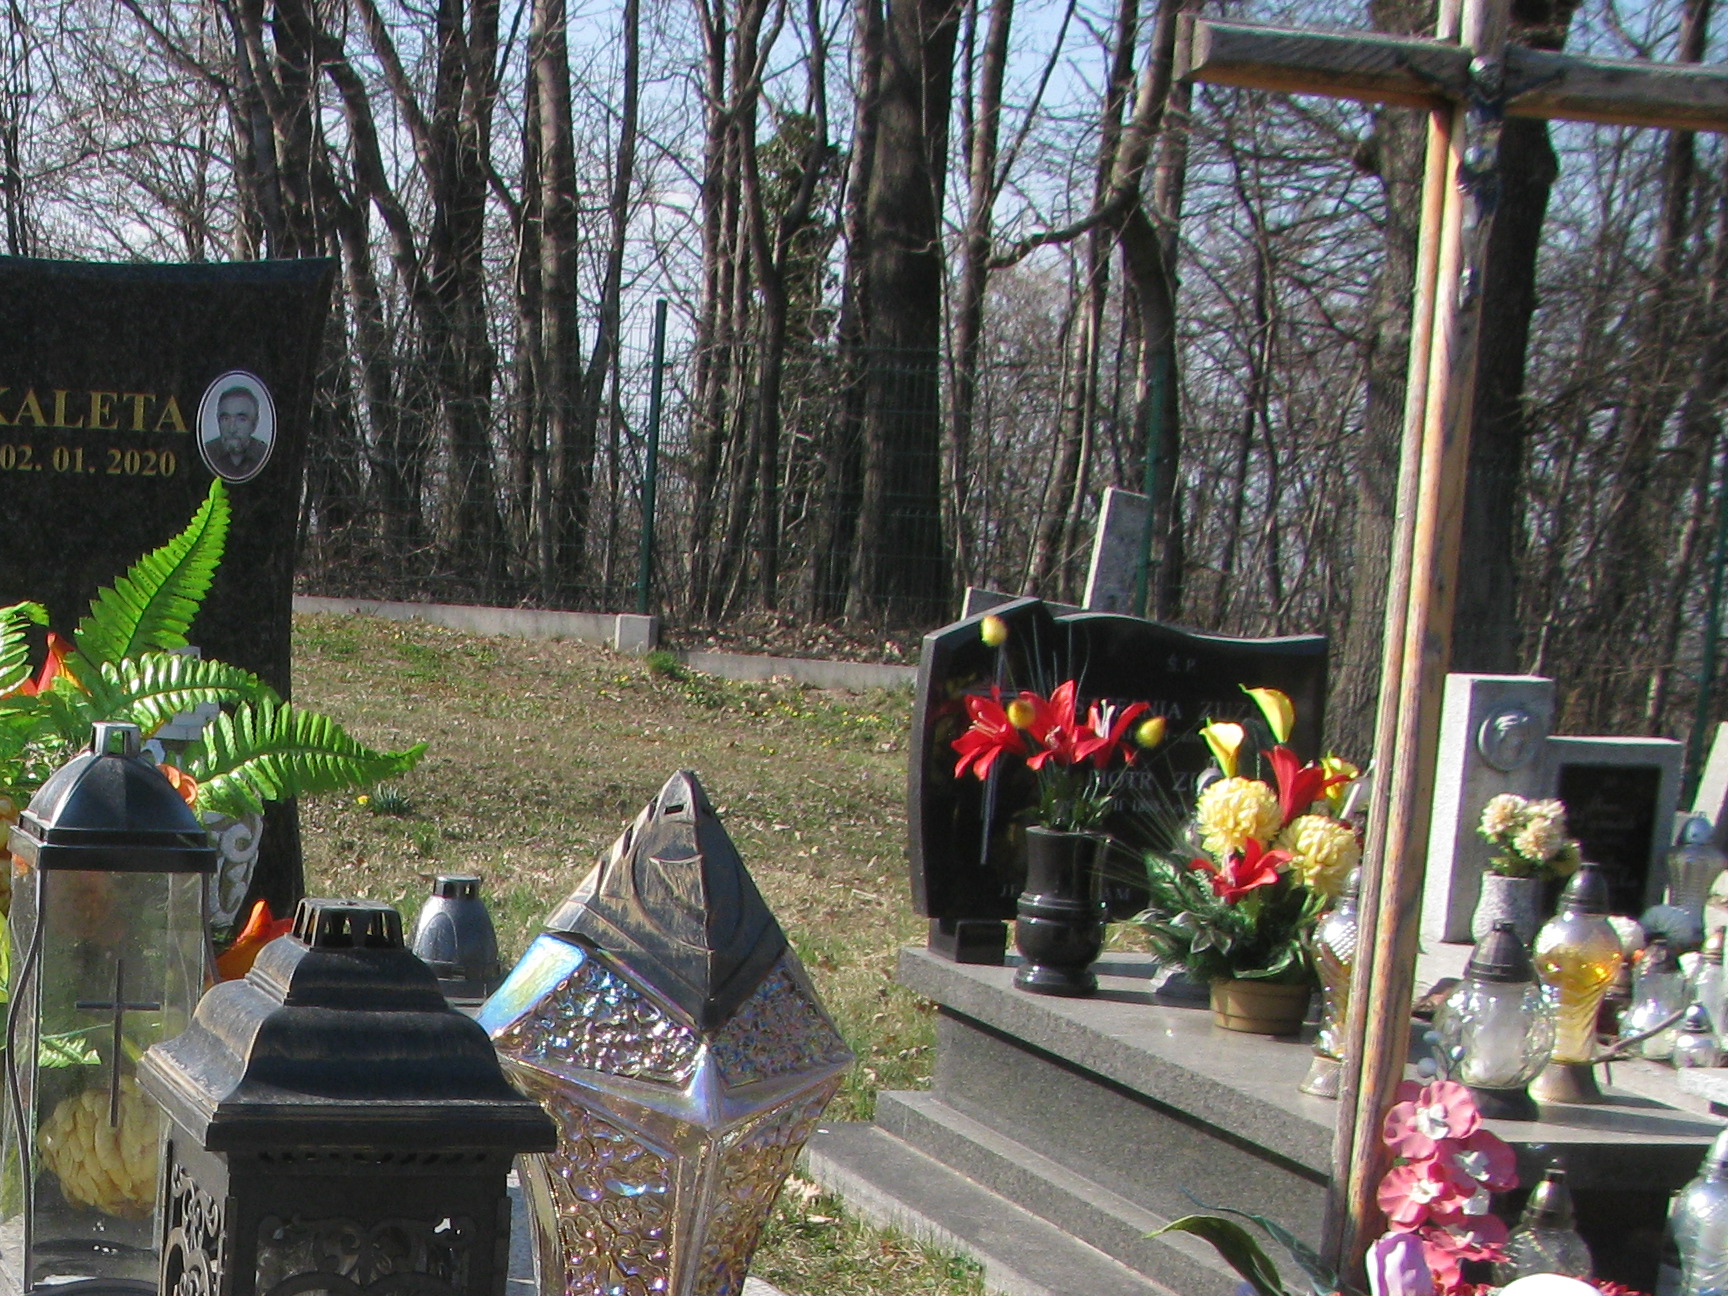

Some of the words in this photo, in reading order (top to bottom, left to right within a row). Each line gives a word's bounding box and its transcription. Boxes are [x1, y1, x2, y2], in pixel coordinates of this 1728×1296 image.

[0, 443, 43, 472] 02.
[52, 446, 97, 474] 01.
[106, 448, 177, 477] 2020
